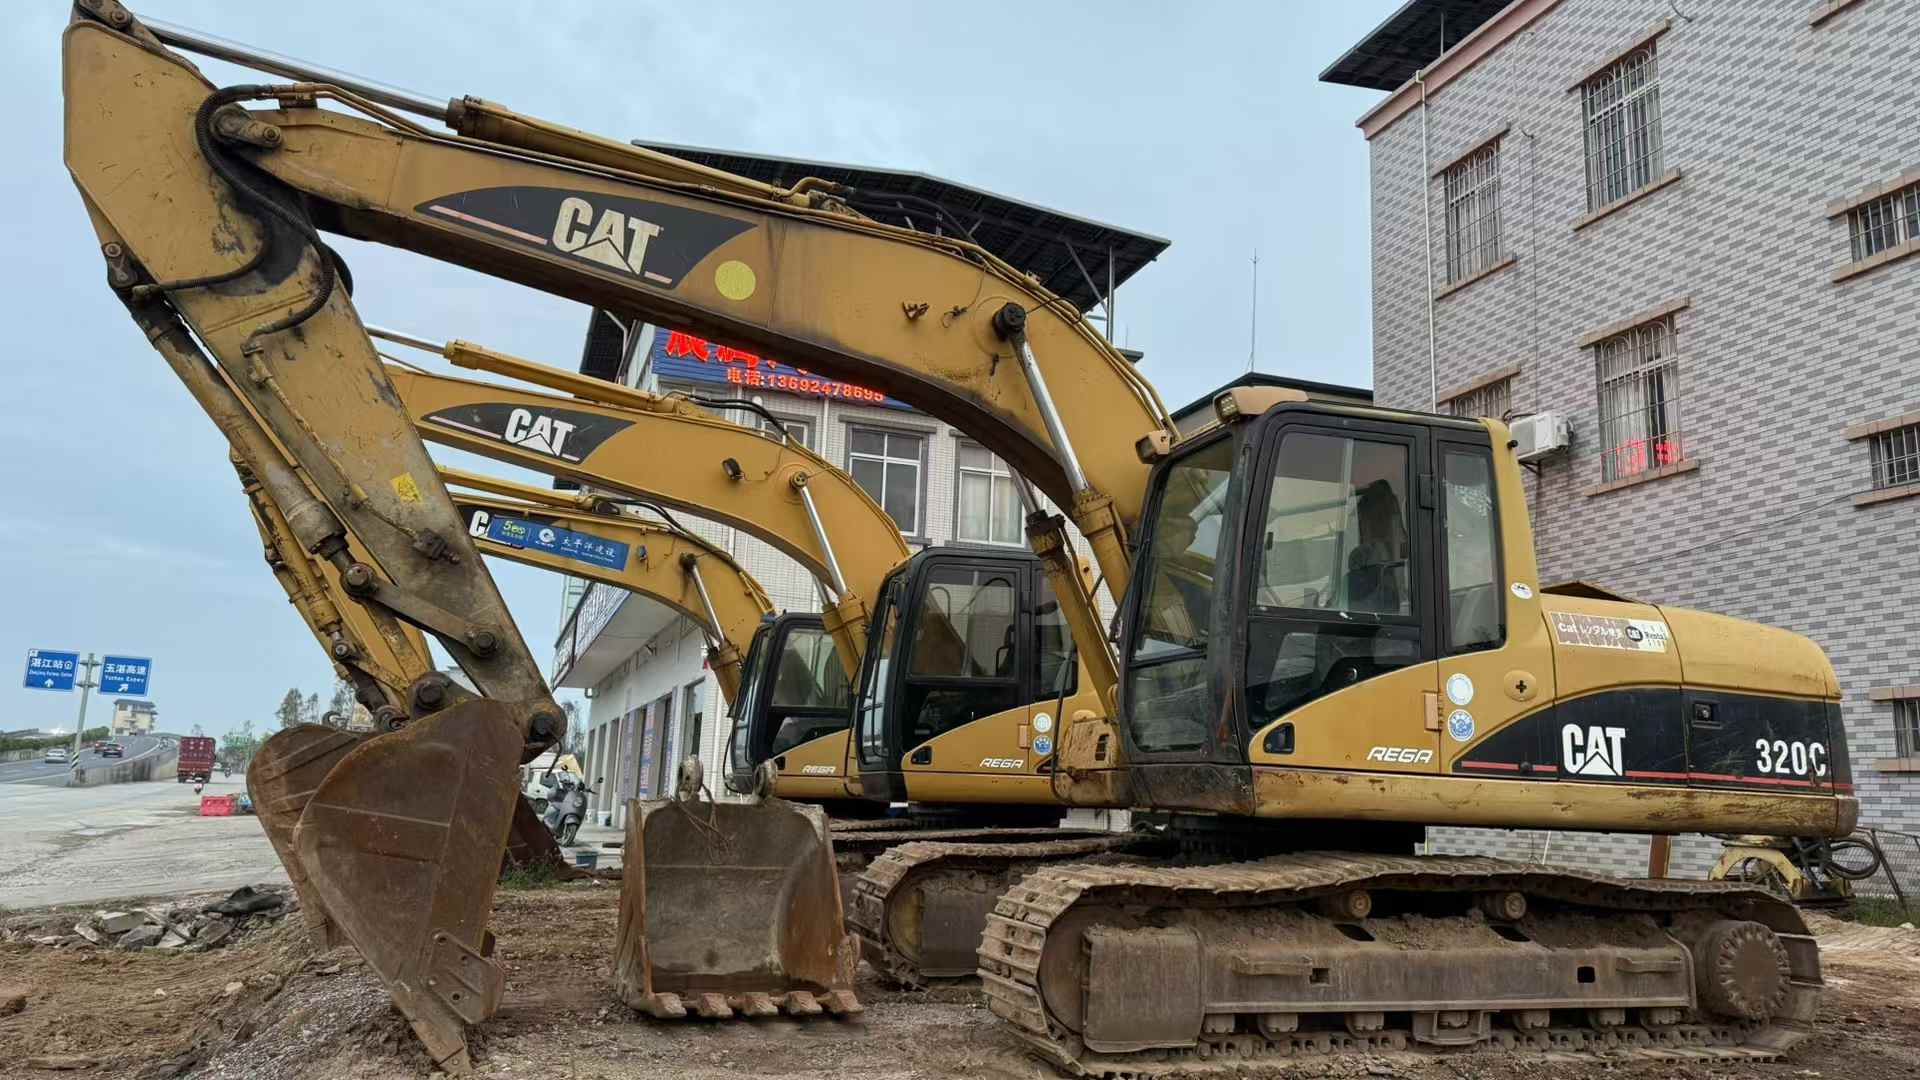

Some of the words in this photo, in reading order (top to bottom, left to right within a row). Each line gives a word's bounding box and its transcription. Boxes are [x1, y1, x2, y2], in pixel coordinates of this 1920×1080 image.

[553, 198, 660, 275] CAT
[504, 408, 573, 456] CAT
[980, 758, 1024, 769] REGA
[1367, 746, 1433, 764] REGA
[1562, 724, 1626, 776] CAT
[1755, 738, 1826, 777] 320C
